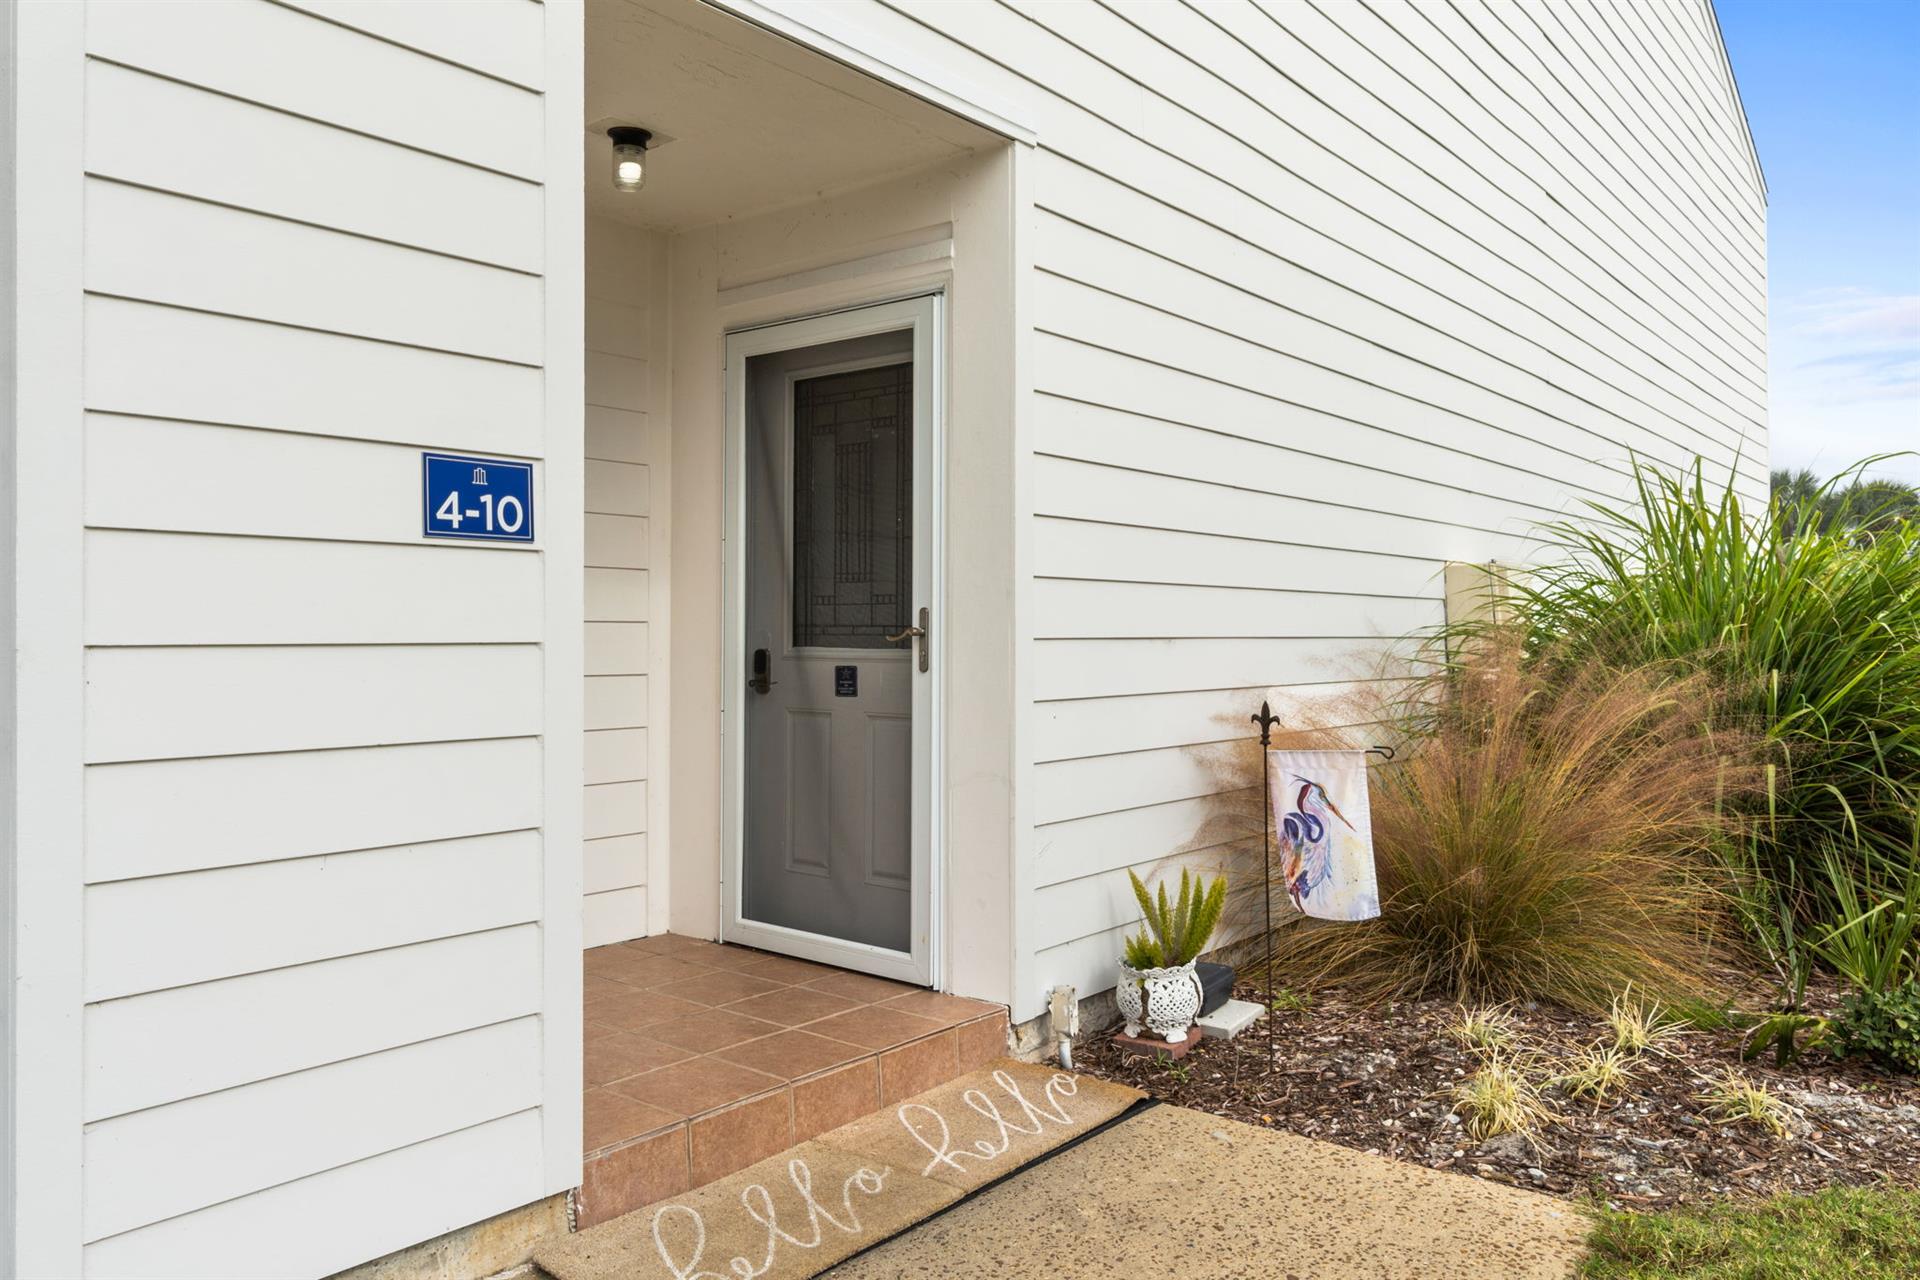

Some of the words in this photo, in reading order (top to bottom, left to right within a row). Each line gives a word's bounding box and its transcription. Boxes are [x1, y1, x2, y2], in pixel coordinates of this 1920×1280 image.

[436, 490, 523, 533] 4-10
[652, 1158, 890, 1280] hello
[898, 1070, 1080, 1178] hello
